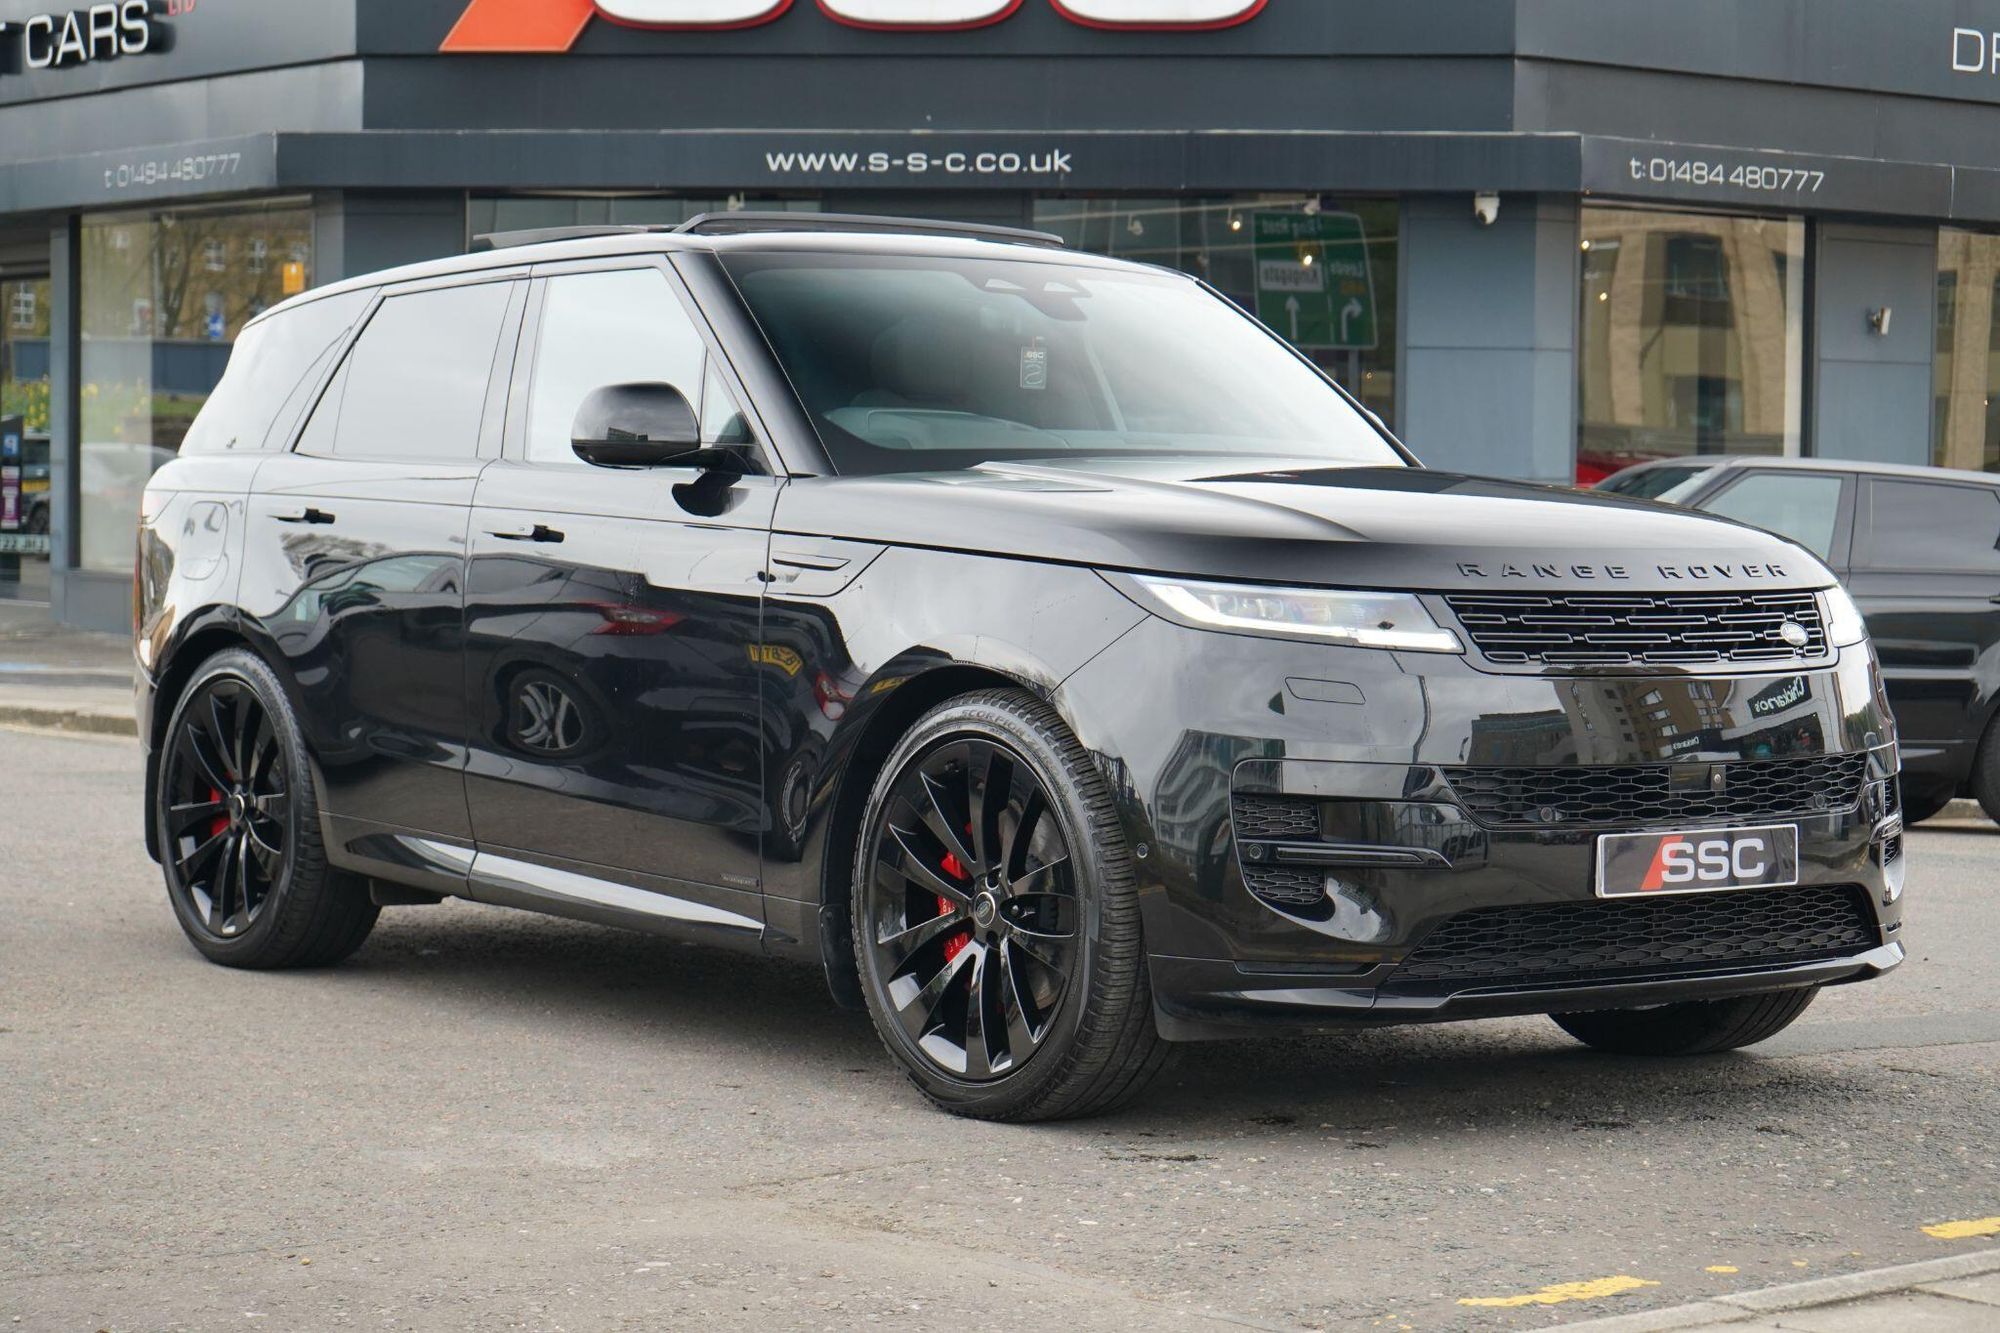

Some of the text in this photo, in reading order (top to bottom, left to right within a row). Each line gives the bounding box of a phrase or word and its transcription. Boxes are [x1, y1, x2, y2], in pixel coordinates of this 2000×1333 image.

[25, 0, 149, 69] CARS
[170, 152, 241, 181] 480777
[766, 149, 1072, 173] www.s-s-c.co.uk
[1650, 158, 1724, 185] 01484
[1729, 165, 1825, 193] 480777
[1456, 562, 1787, 580] RANGE ROVER
[962, 709, 1025, 738] SCORPION
[1661, 838, 1764, 882] SSC
